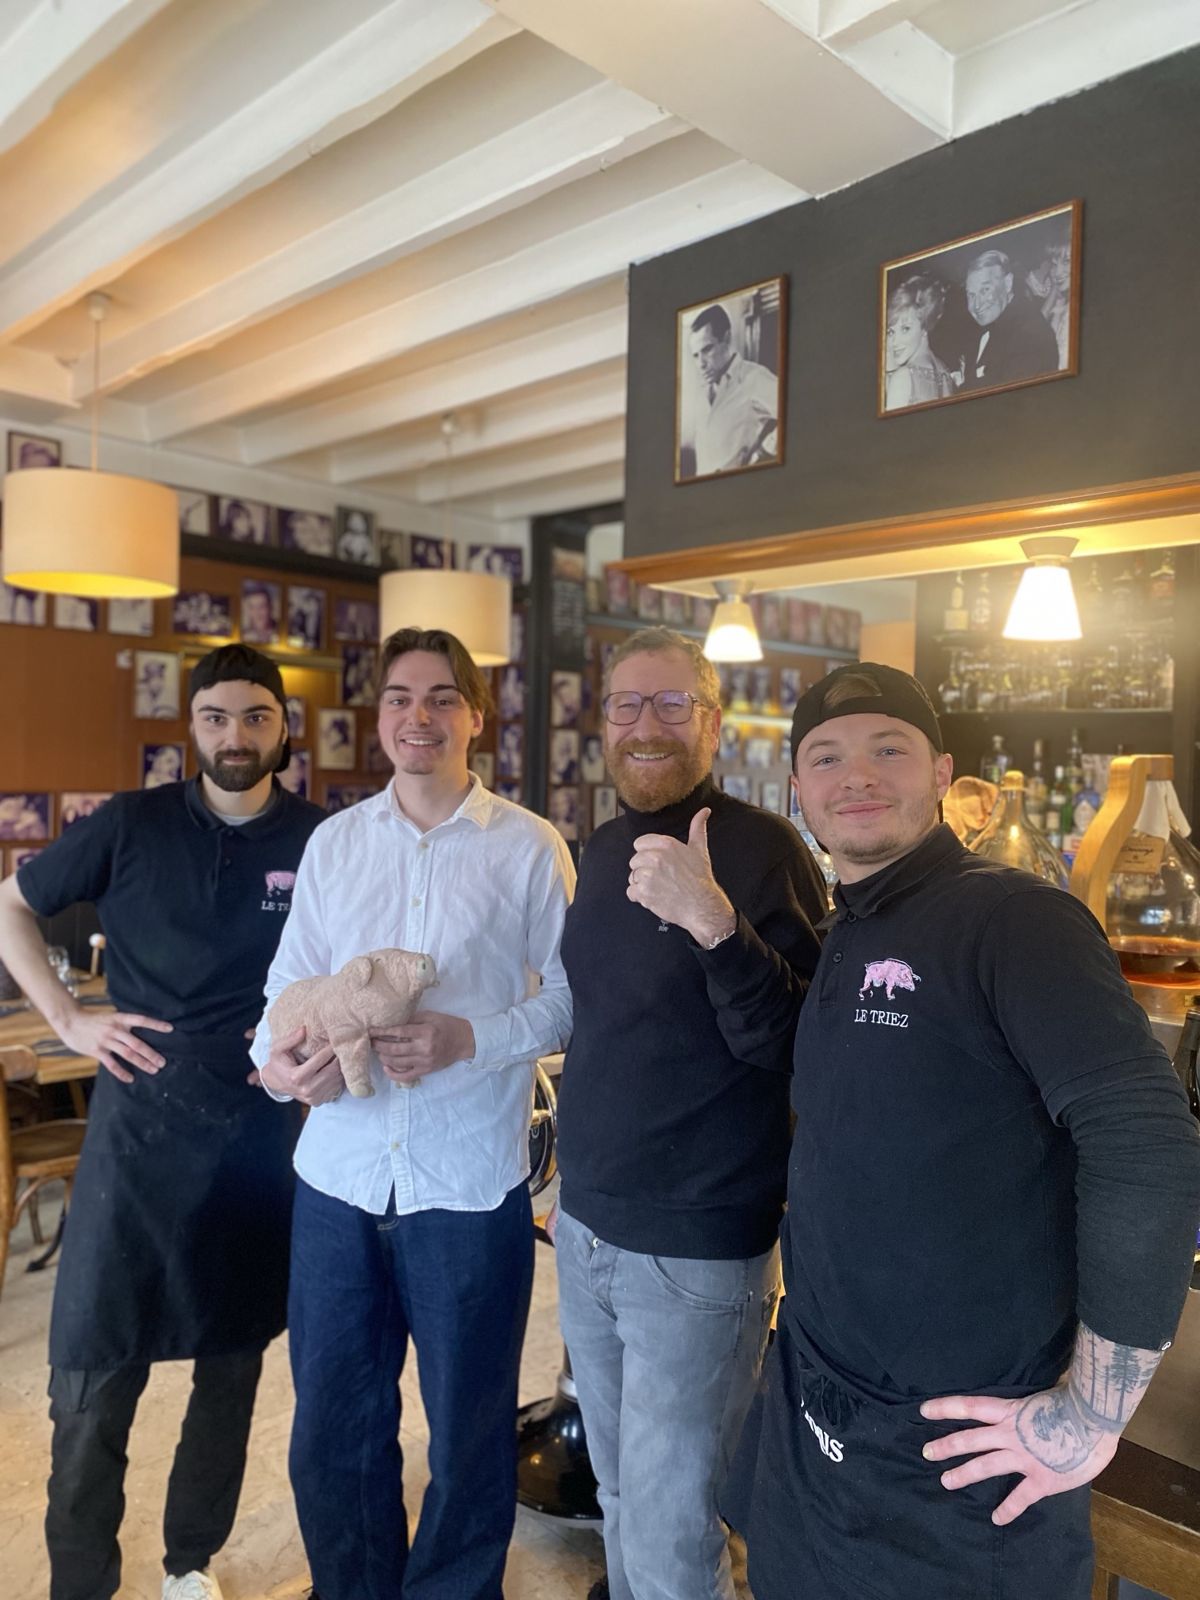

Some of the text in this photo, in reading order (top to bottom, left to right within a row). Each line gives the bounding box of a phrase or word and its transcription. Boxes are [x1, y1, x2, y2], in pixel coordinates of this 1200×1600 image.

[261, 900, 276, 911] LE
[854, 1009, 909, 1028] LE TRIEZ
